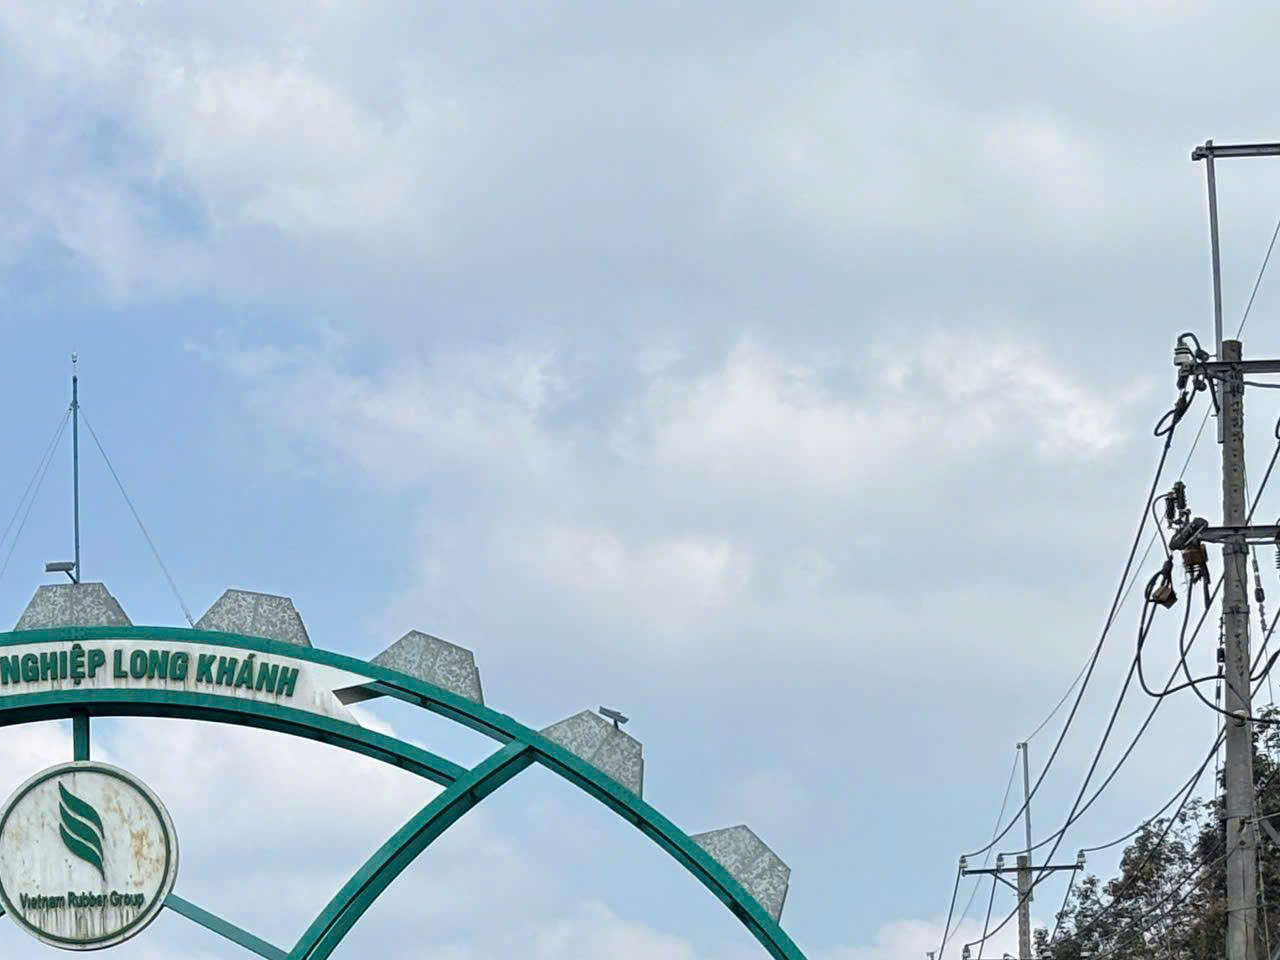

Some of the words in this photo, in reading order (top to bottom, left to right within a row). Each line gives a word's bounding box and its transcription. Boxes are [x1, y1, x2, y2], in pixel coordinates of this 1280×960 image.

[0, 643, 107, 687] NGHIỆP
[113, 648, 187, 681] LONG
[195, 653, 300, 698] KHÁNH
[19, 892, 66, 910] Vietnam
[67, 890, 108, 911] Rubber
[109, 890, 145, 910] Group
